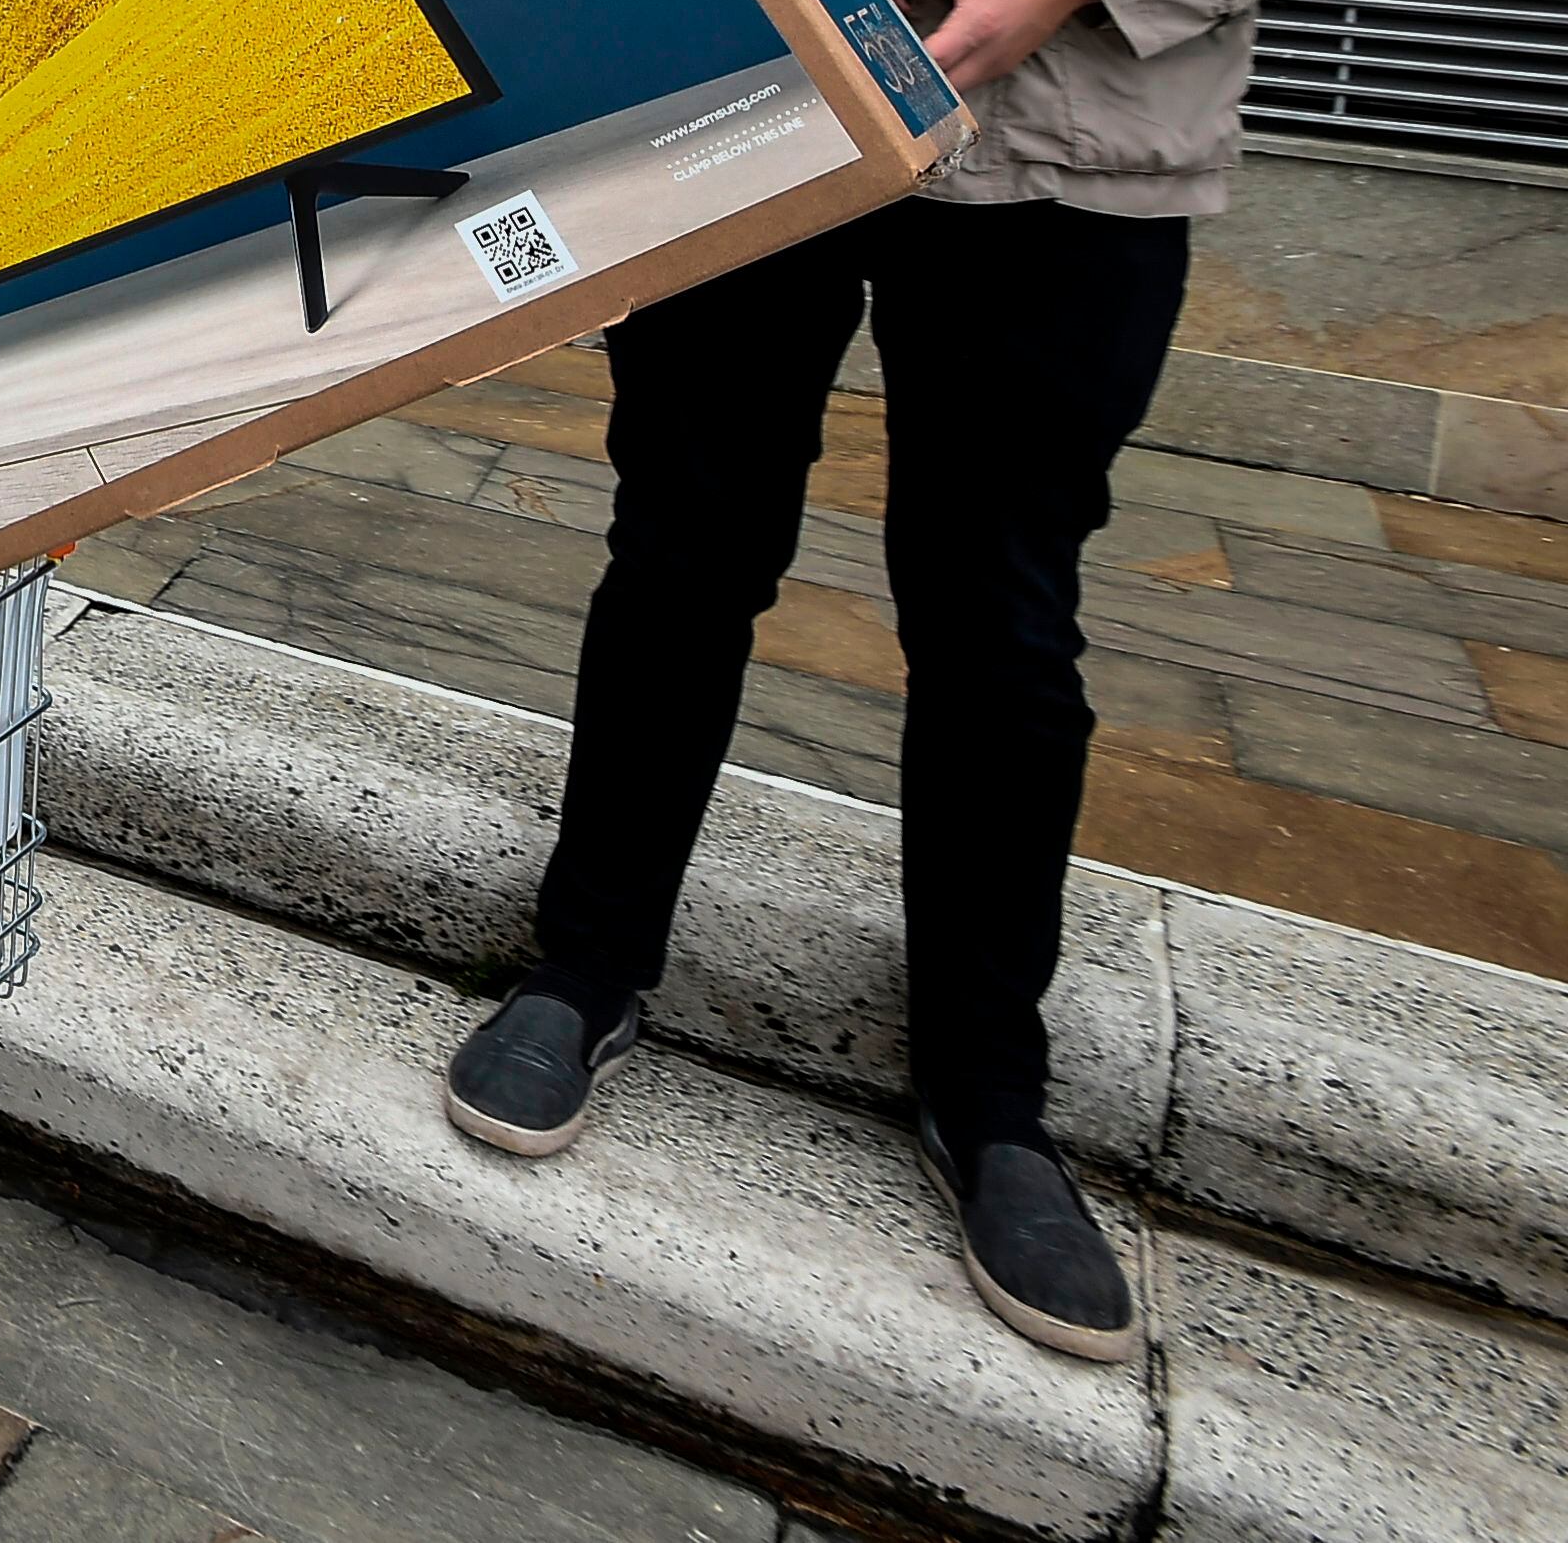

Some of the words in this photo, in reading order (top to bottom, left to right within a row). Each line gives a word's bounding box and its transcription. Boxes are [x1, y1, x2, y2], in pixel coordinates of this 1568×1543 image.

[651, 81, 781, 150] www.samsung.com
[673, 157, 712, 183] CLAMP
[711, 140, 753, 167] BELOW
[751, 126, 778, 149] THIS
[777, 116, 806, 139] LINE
